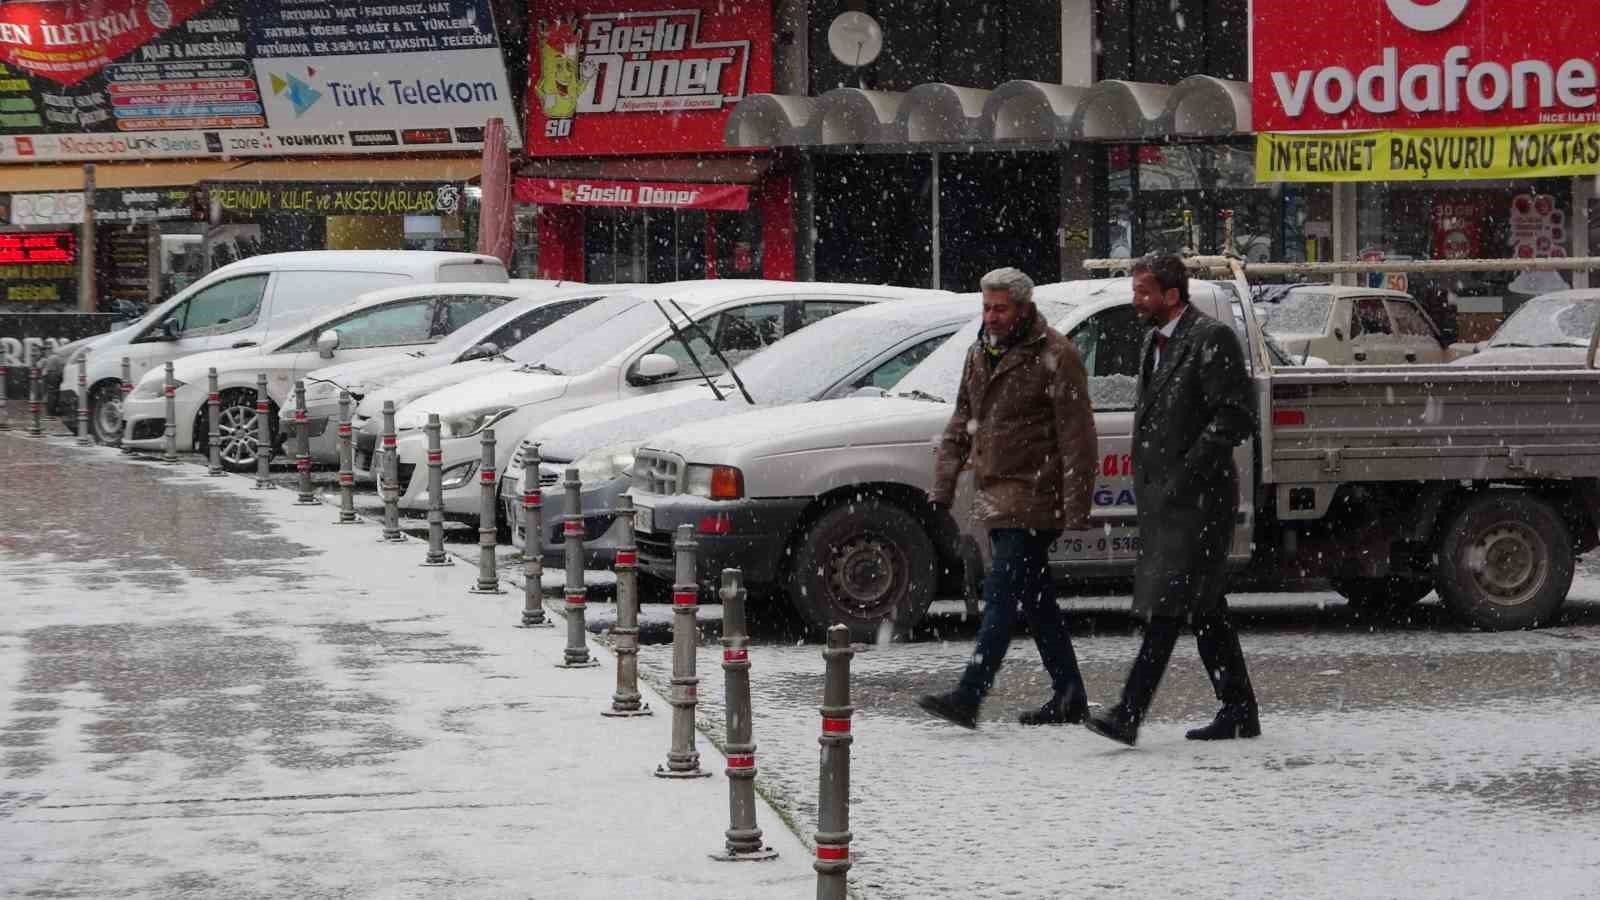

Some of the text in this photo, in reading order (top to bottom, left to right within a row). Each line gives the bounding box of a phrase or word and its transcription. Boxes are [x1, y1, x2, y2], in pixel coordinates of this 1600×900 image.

[336, 7, 357, 18] HAT
[429, 2, 450, 13] HAT
[373, 38, 387, 49] AY
[442, 32, 492, 46] TELEFON
[586, 18, 687, 53] Soslu
[173, 44, 184, 57] &
[327, 78, 498, 107] Türk Telekom
[576, 52, 734, 112] Döner
[1271, 45, 1597, 117] vodafone
[1389, 135, 1495, 177] BAŞVURU
[335, 189, 434, 211] AKSESUARLAR
[576, 184, 700, 205] Soslu Döner
